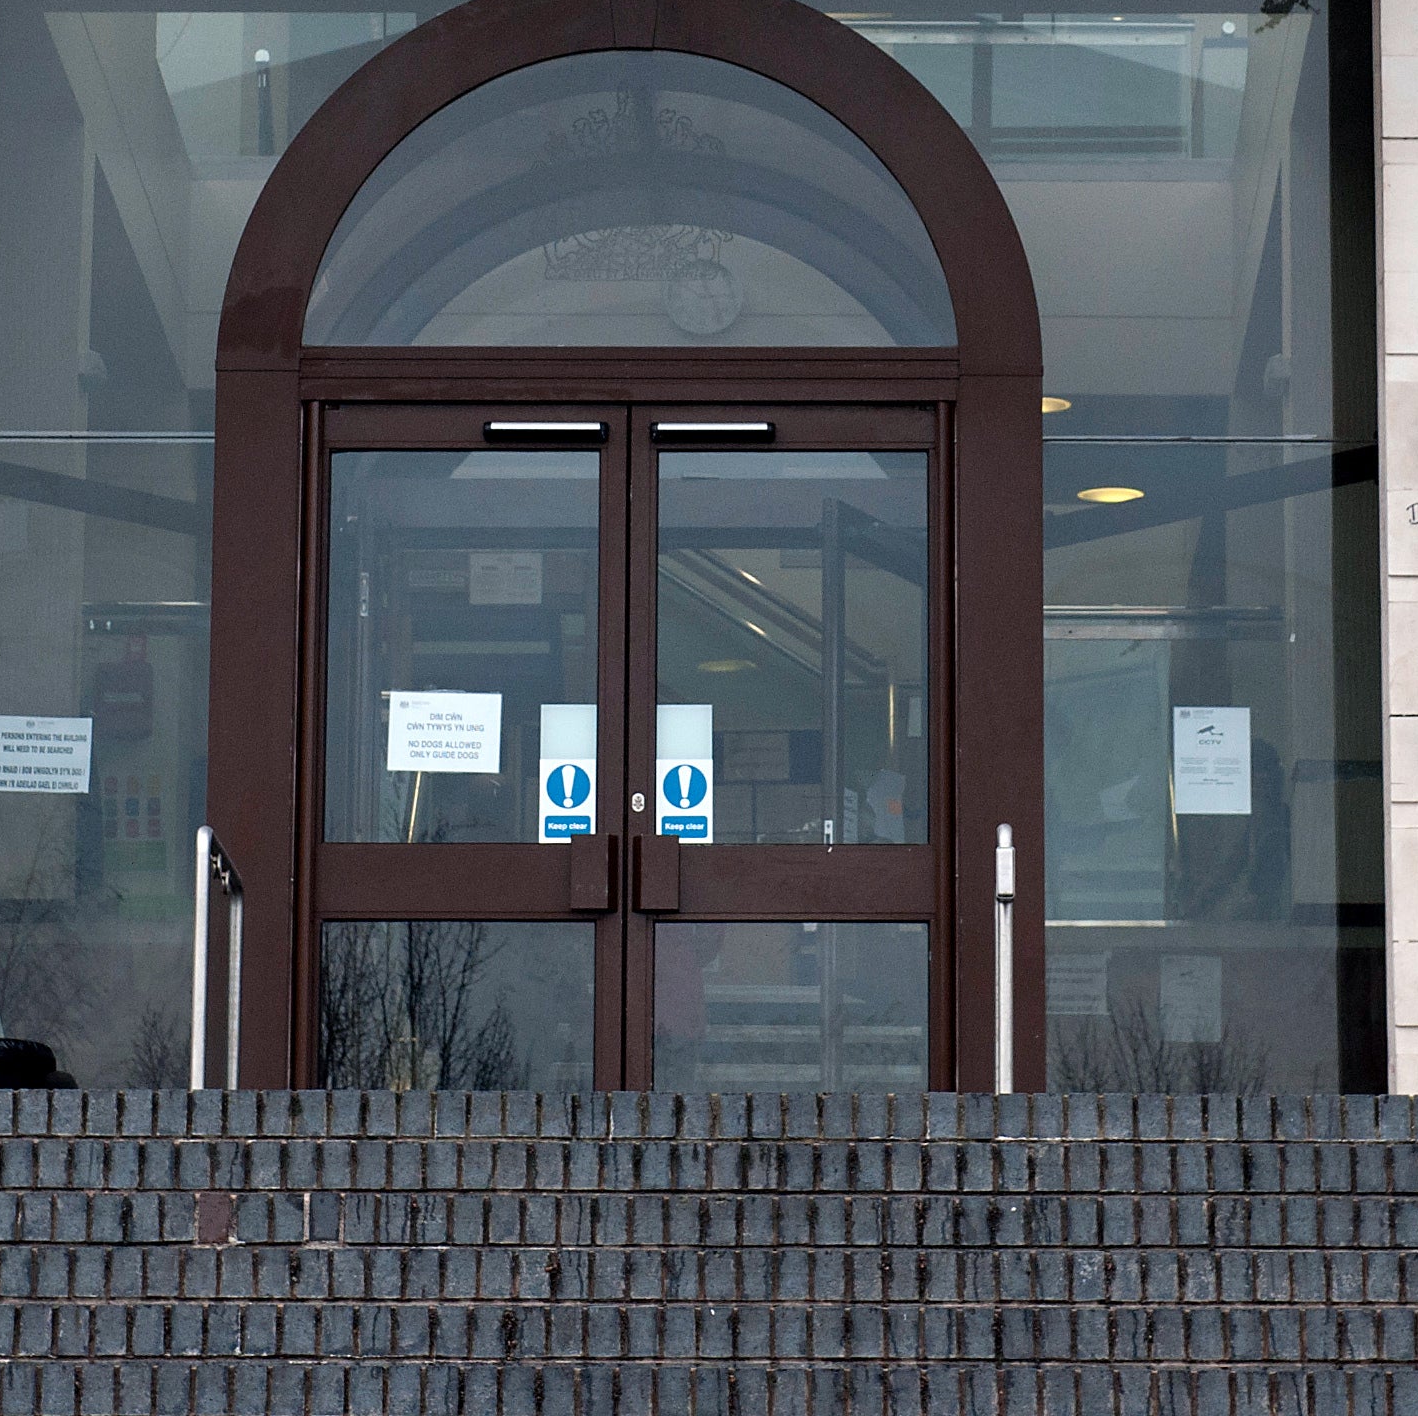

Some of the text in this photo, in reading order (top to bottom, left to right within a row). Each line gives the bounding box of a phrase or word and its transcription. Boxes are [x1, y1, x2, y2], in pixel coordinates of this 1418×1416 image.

[408, 740, 482, 749] NO DOGS ALLOWED
[410, 750, 430, 758] ONLY
[547, 822, 588, 831] Keep clear
[664, 822, 705, 831] Keep clear
